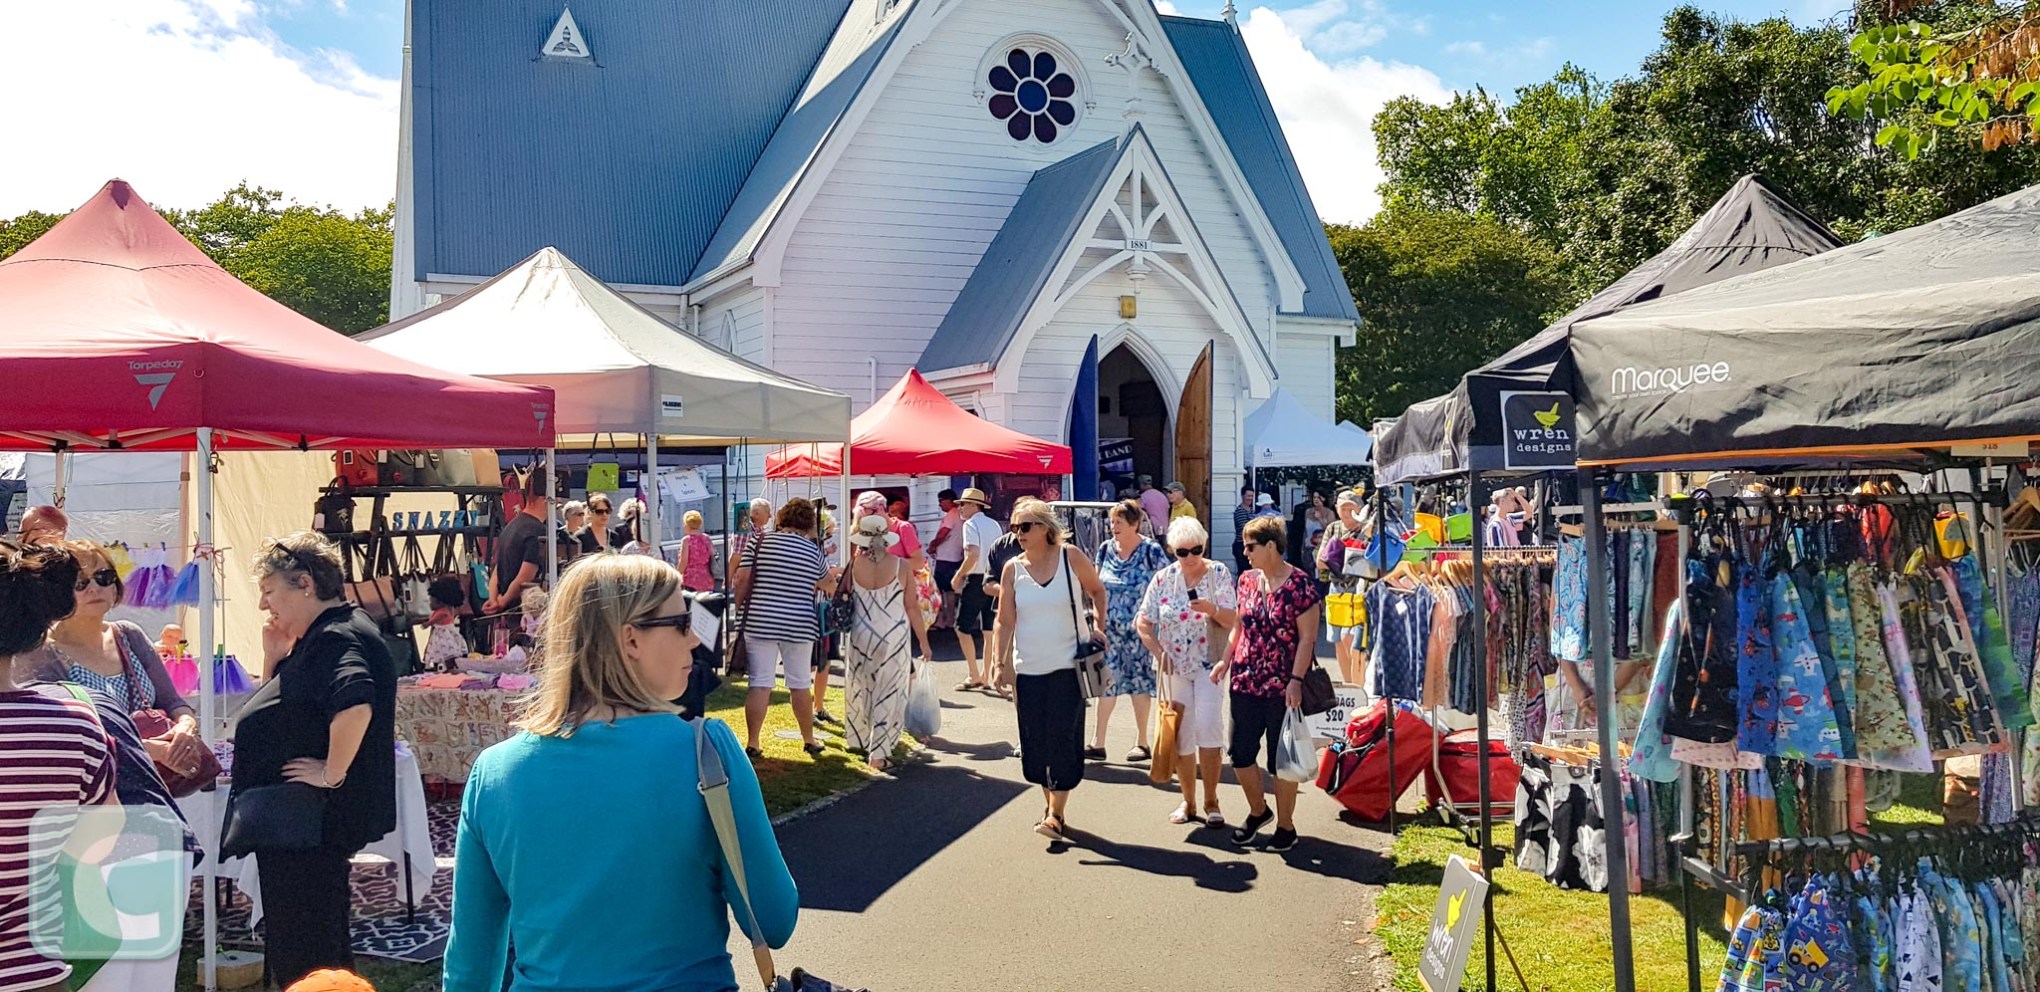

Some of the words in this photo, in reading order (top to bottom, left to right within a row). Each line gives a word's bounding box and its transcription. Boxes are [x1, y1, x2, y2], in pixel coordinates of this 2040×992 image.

[1130, 240, 1148, 250] 1881
[1513, 428, 1569, 440] wren
[1104, 444, 1133, 459] BAND
[1516, 442, 1571, 454] designs
[392, 510, 480, 532] SNAZZY
[1325, 708, 1344, 723] $20
[1431, 917, 1454, 964] wren
[1425, 943, 1446, 980] designs
